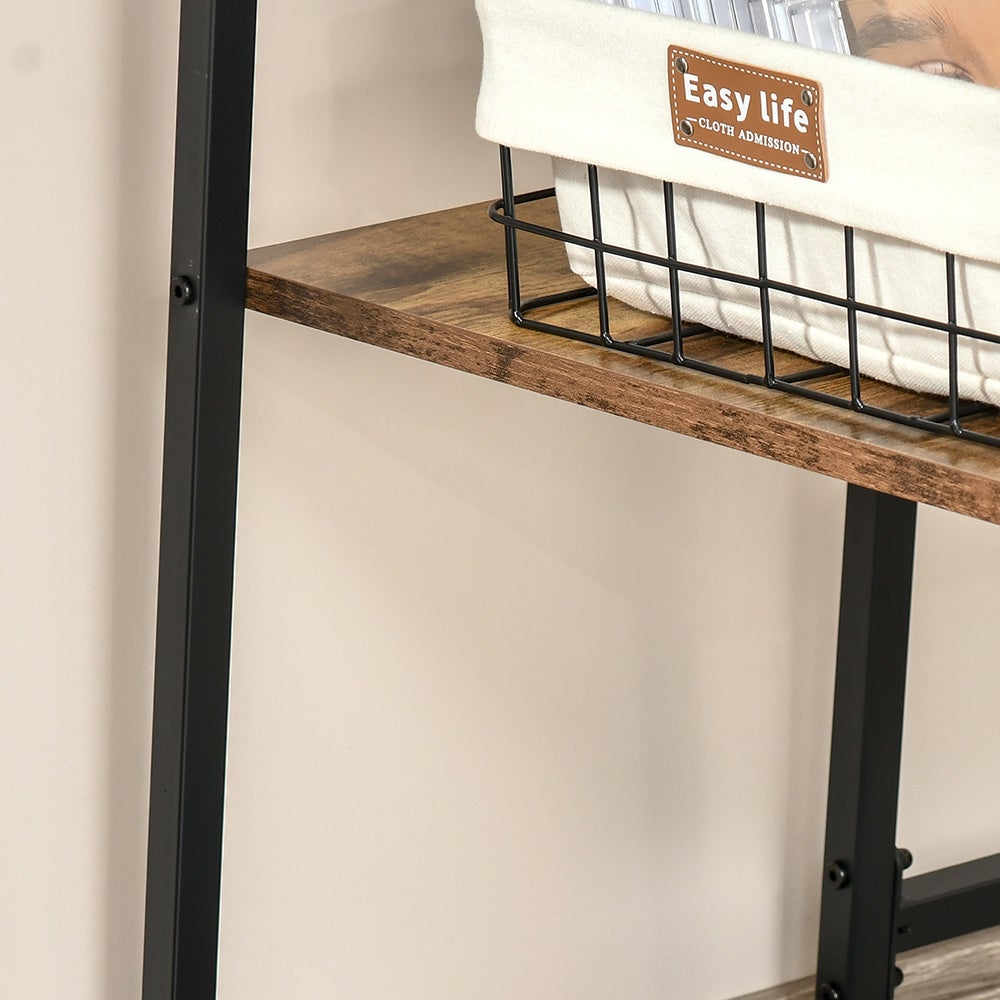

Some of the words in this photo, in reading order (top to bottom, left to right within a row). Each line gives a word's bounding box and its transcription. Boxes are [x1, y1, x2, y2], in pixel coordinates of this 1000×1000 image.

[683, 72, 751, 122] Easy
[760, 90, 809, 133] life
[698, 117, 735, 137] CLOTH
[738, 129, 800, 155] ADMISSION
